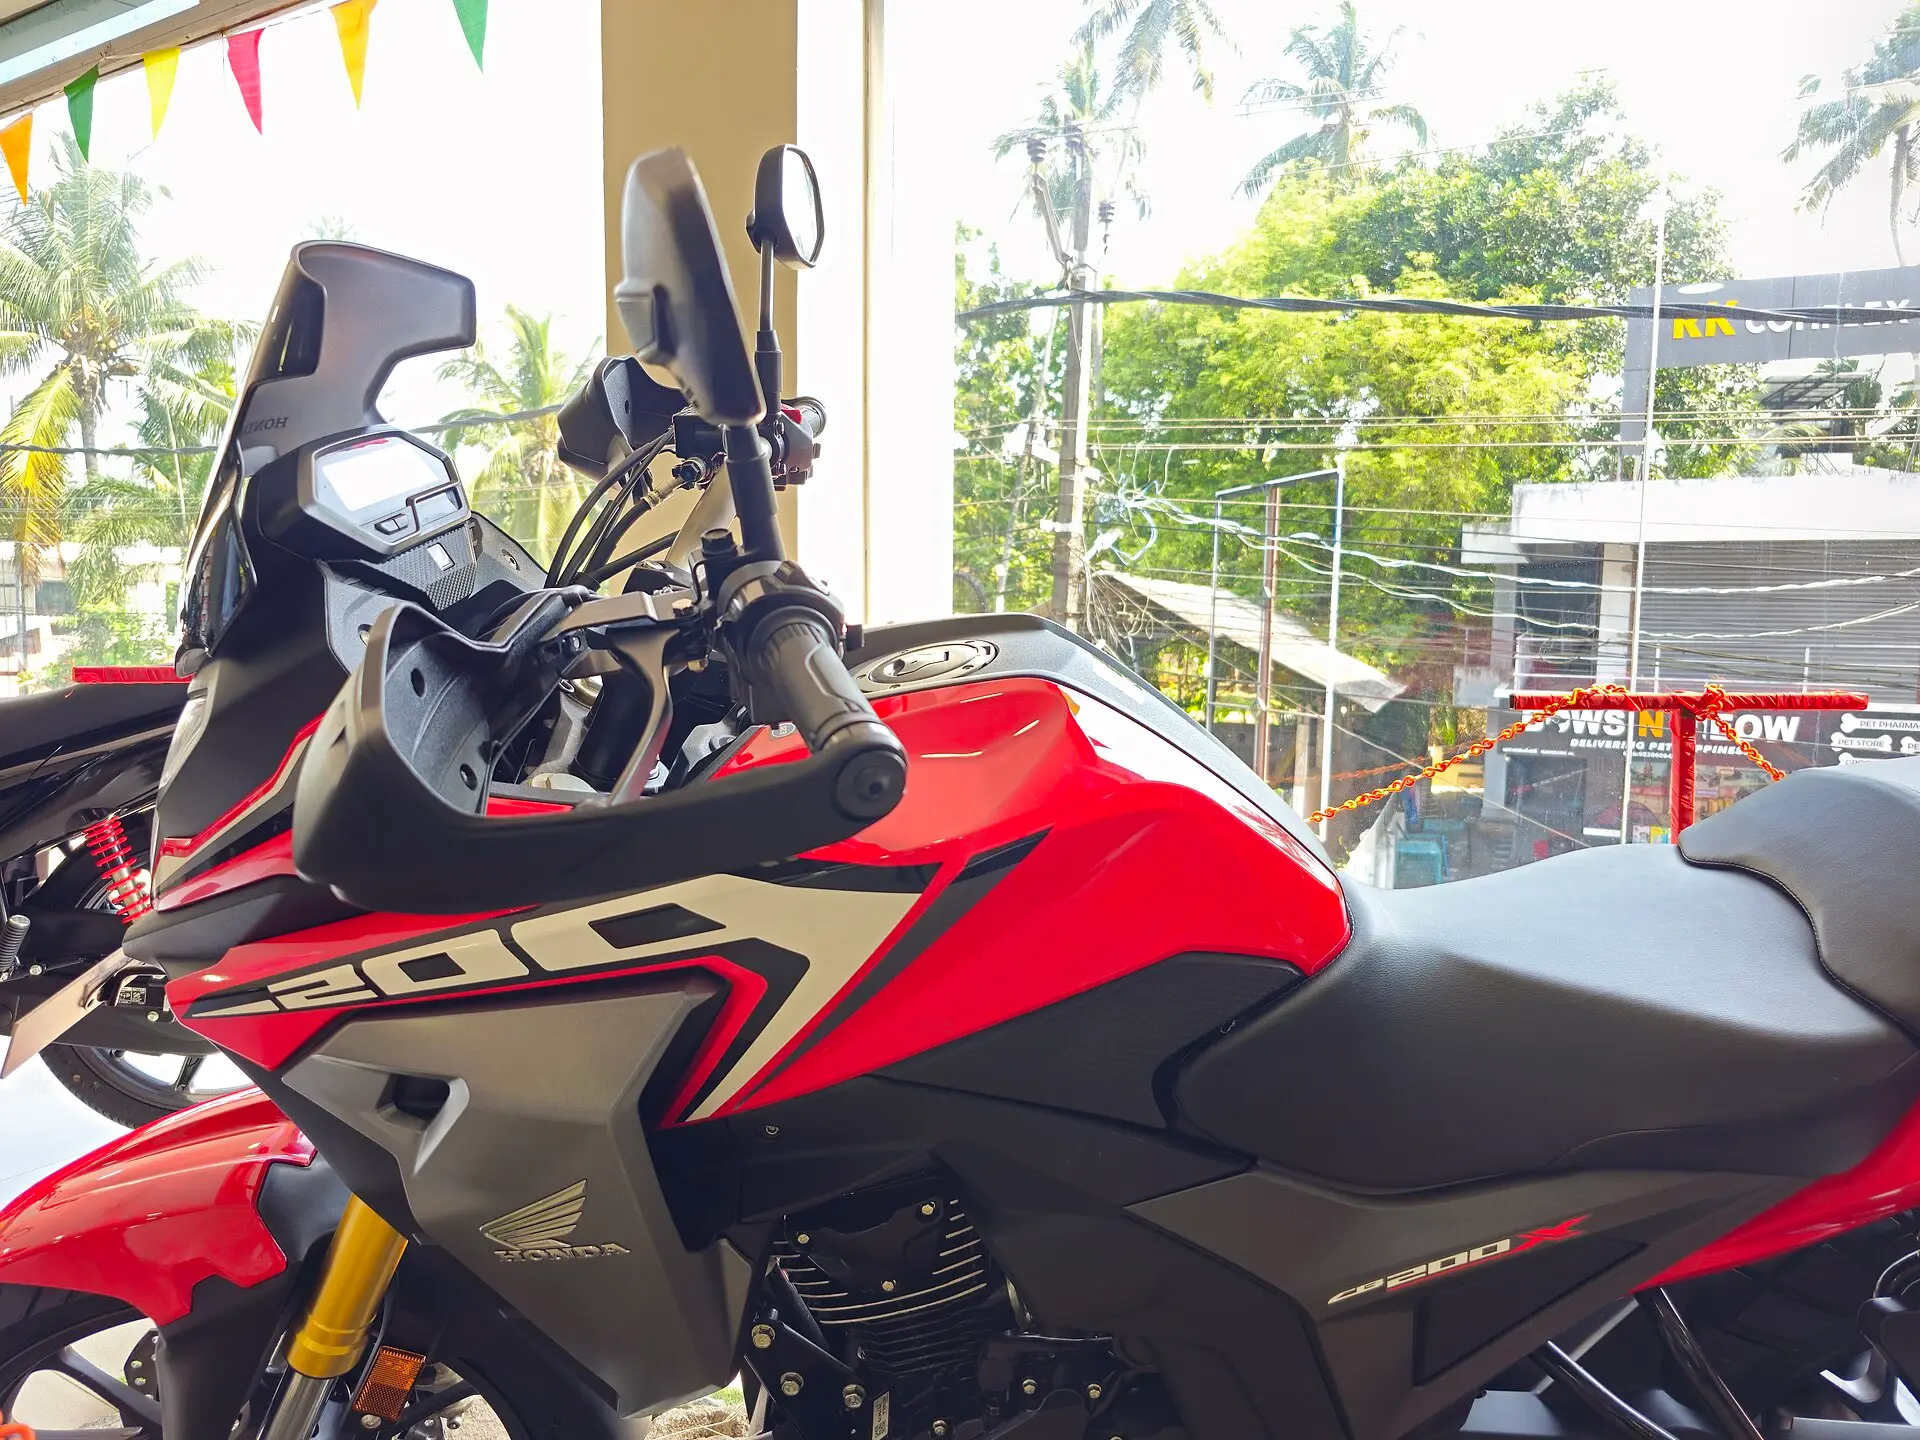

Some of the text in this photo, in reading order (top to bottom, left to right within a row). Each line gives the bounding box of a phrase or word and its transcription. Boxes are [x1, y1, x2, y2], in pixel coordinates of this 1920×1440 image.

[1638, 710, 1665, 738] N
[1695, 712, 1801, 743] EOW
[1859, 720, 1920, 729] PET PHARMA
[1856, 739, 1885, 748] STORE
[1907, 742, 1920, 750] PE
[267, 874, 740, 1009] 200
[493, 1243, 631, 1262] HONDA
